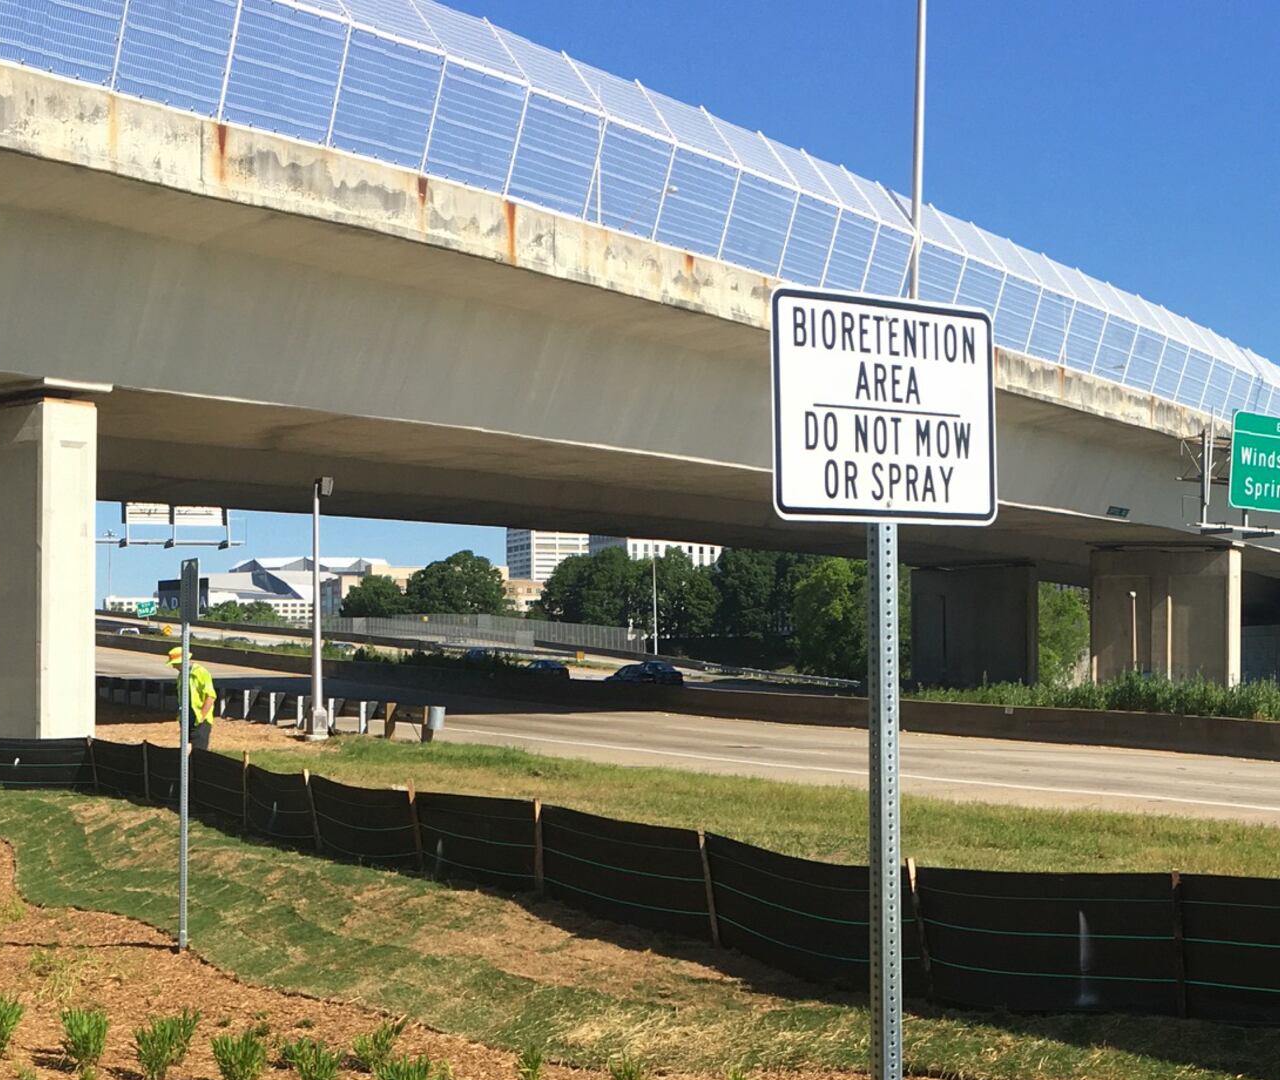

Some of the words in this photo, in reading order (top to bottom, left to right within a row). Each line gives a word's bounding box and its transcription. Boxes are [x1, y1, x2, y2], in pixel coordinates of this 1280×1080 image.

[792, 306, 976, 365] BIORETENTION
[855, 361, 921, 405] AREA
[804, 411, 838, 452] DO
[854, 414, 902, 455] NOT
[916, 419, 972, 459] MOW
[824, 458, 858, 500] OR
[871, 463, 954, 503] SPRAY
